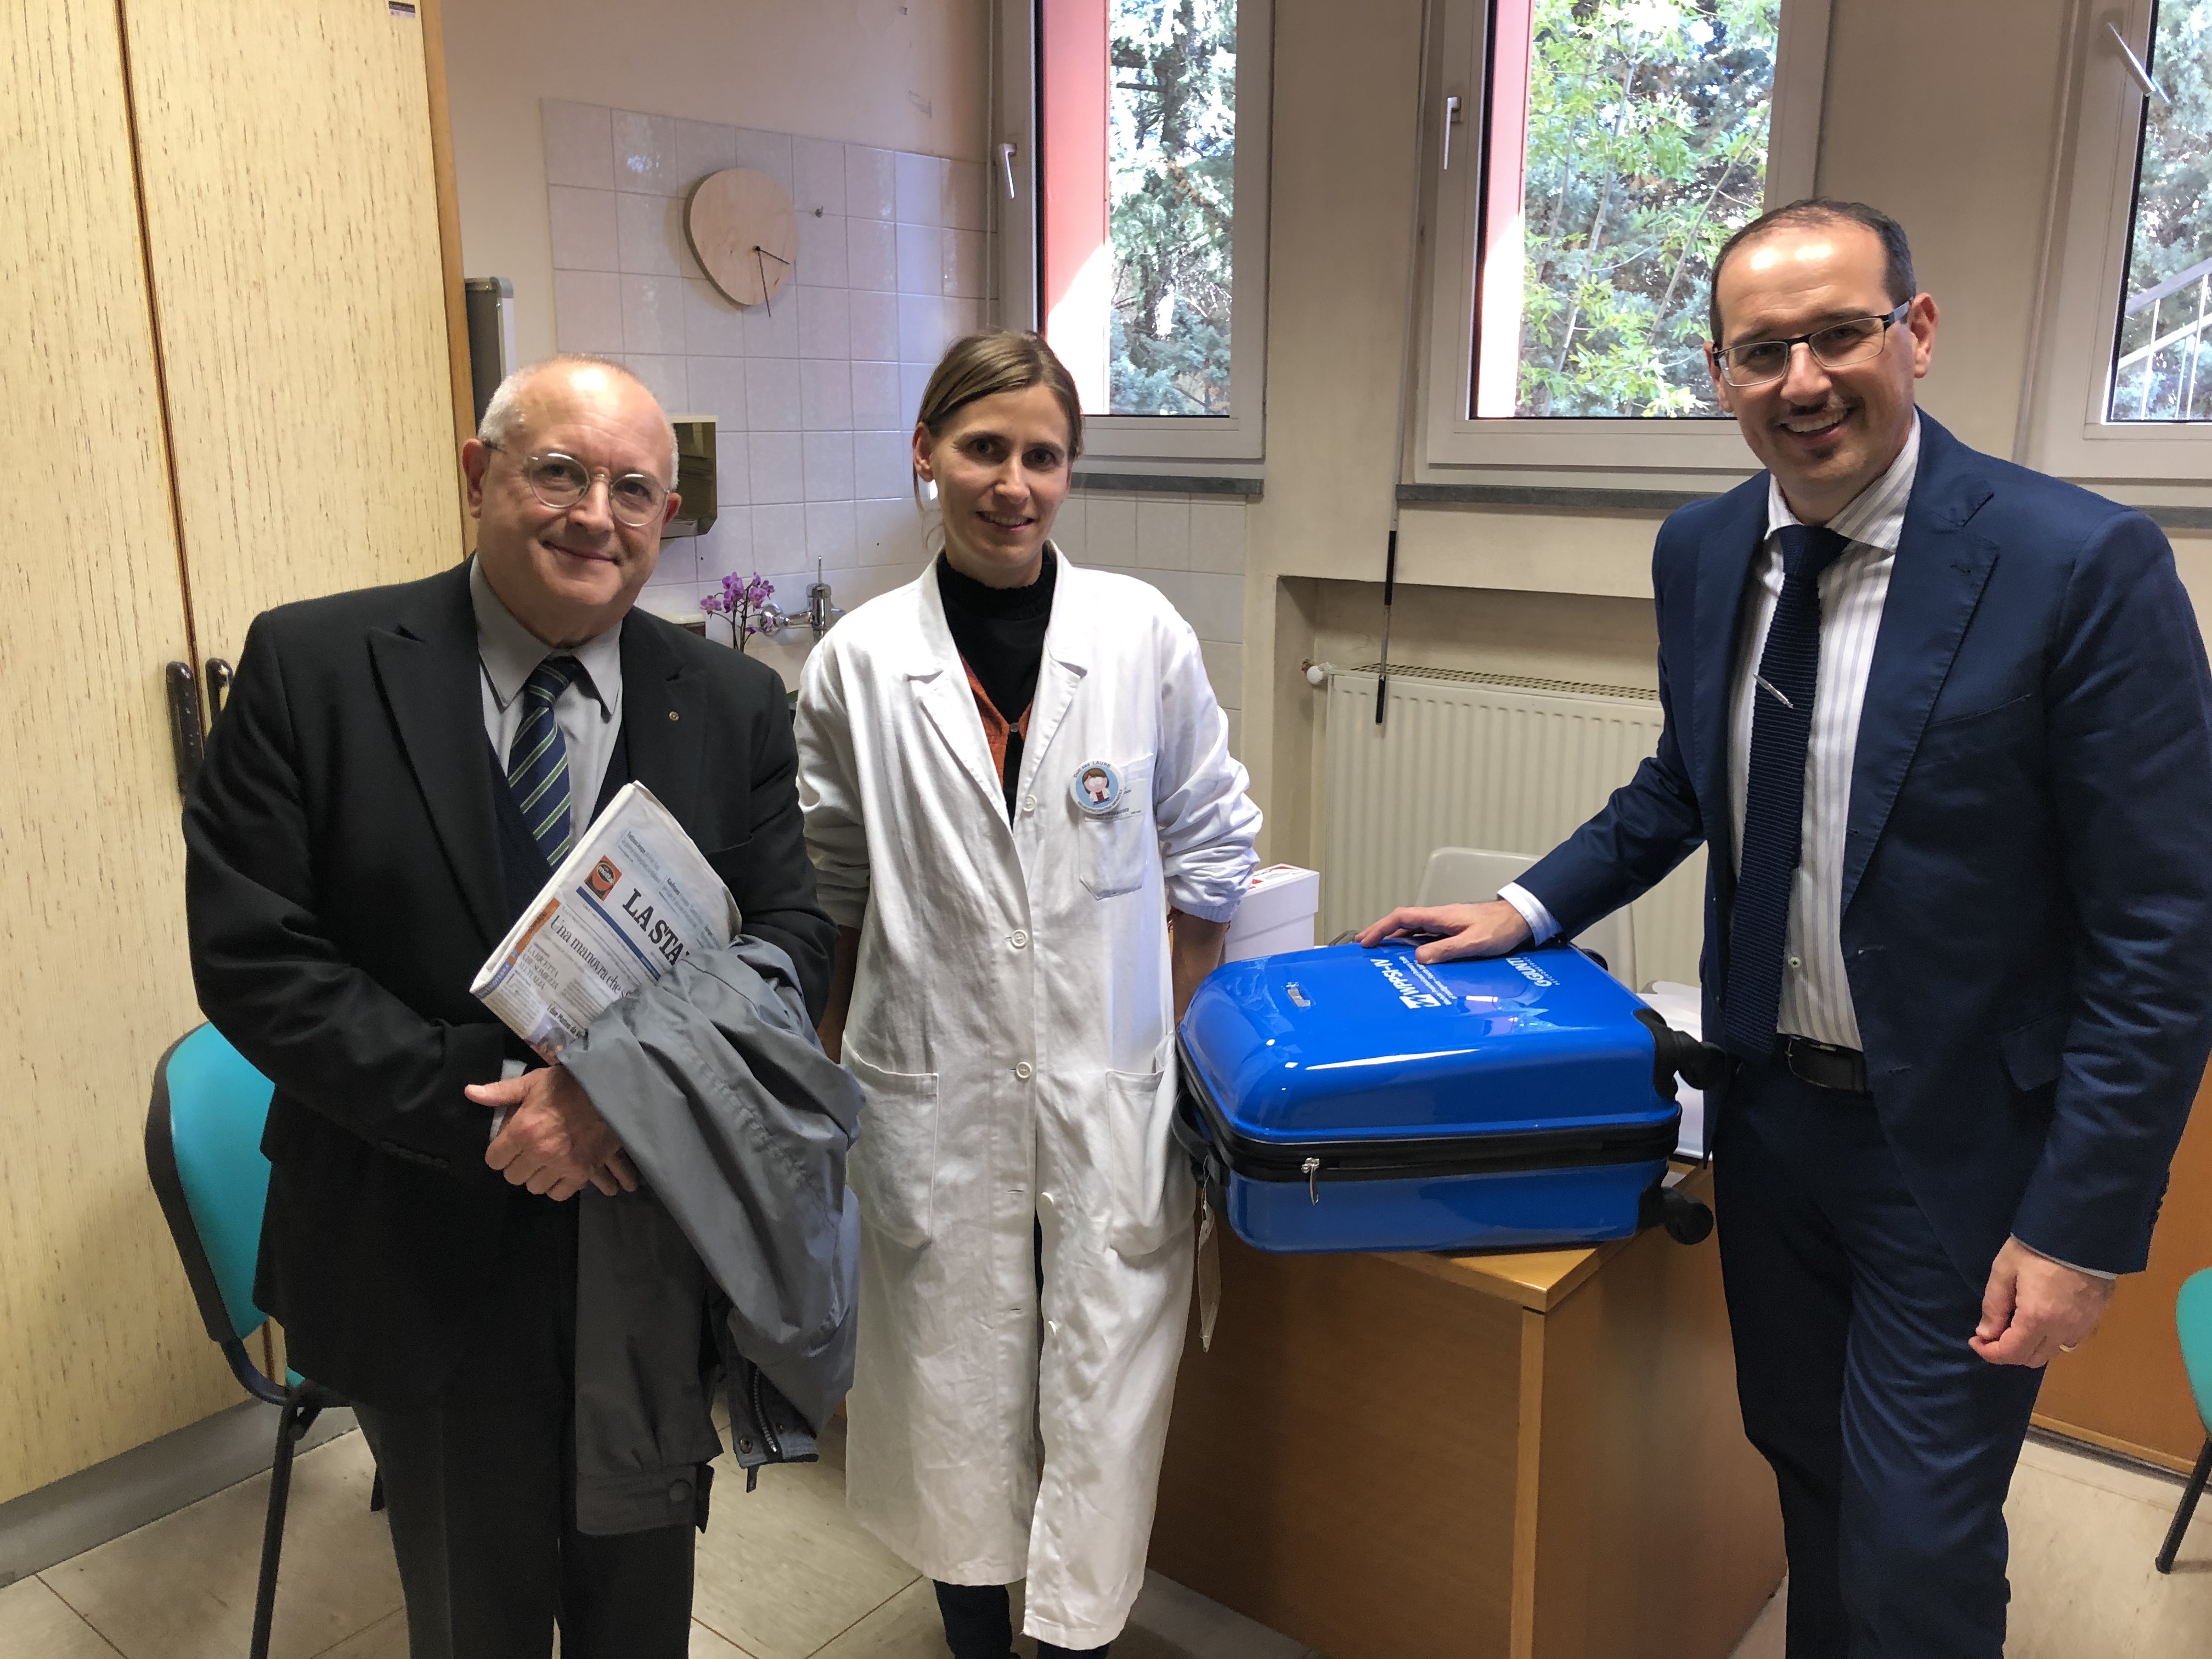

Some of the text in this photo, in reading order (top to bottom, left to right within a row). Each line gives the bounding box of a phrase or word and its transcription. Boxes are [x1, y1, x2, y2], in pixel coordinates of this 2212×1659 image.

[550, 915, 572, 943] Una
[570, 938, 608, 981] manovra
[606, 975, 621, 995] che
[622, 887, 654, 932] LA
[648, 919, 690, 966] STA
[1370, 958, 1420, 996] WPPSI-IV
